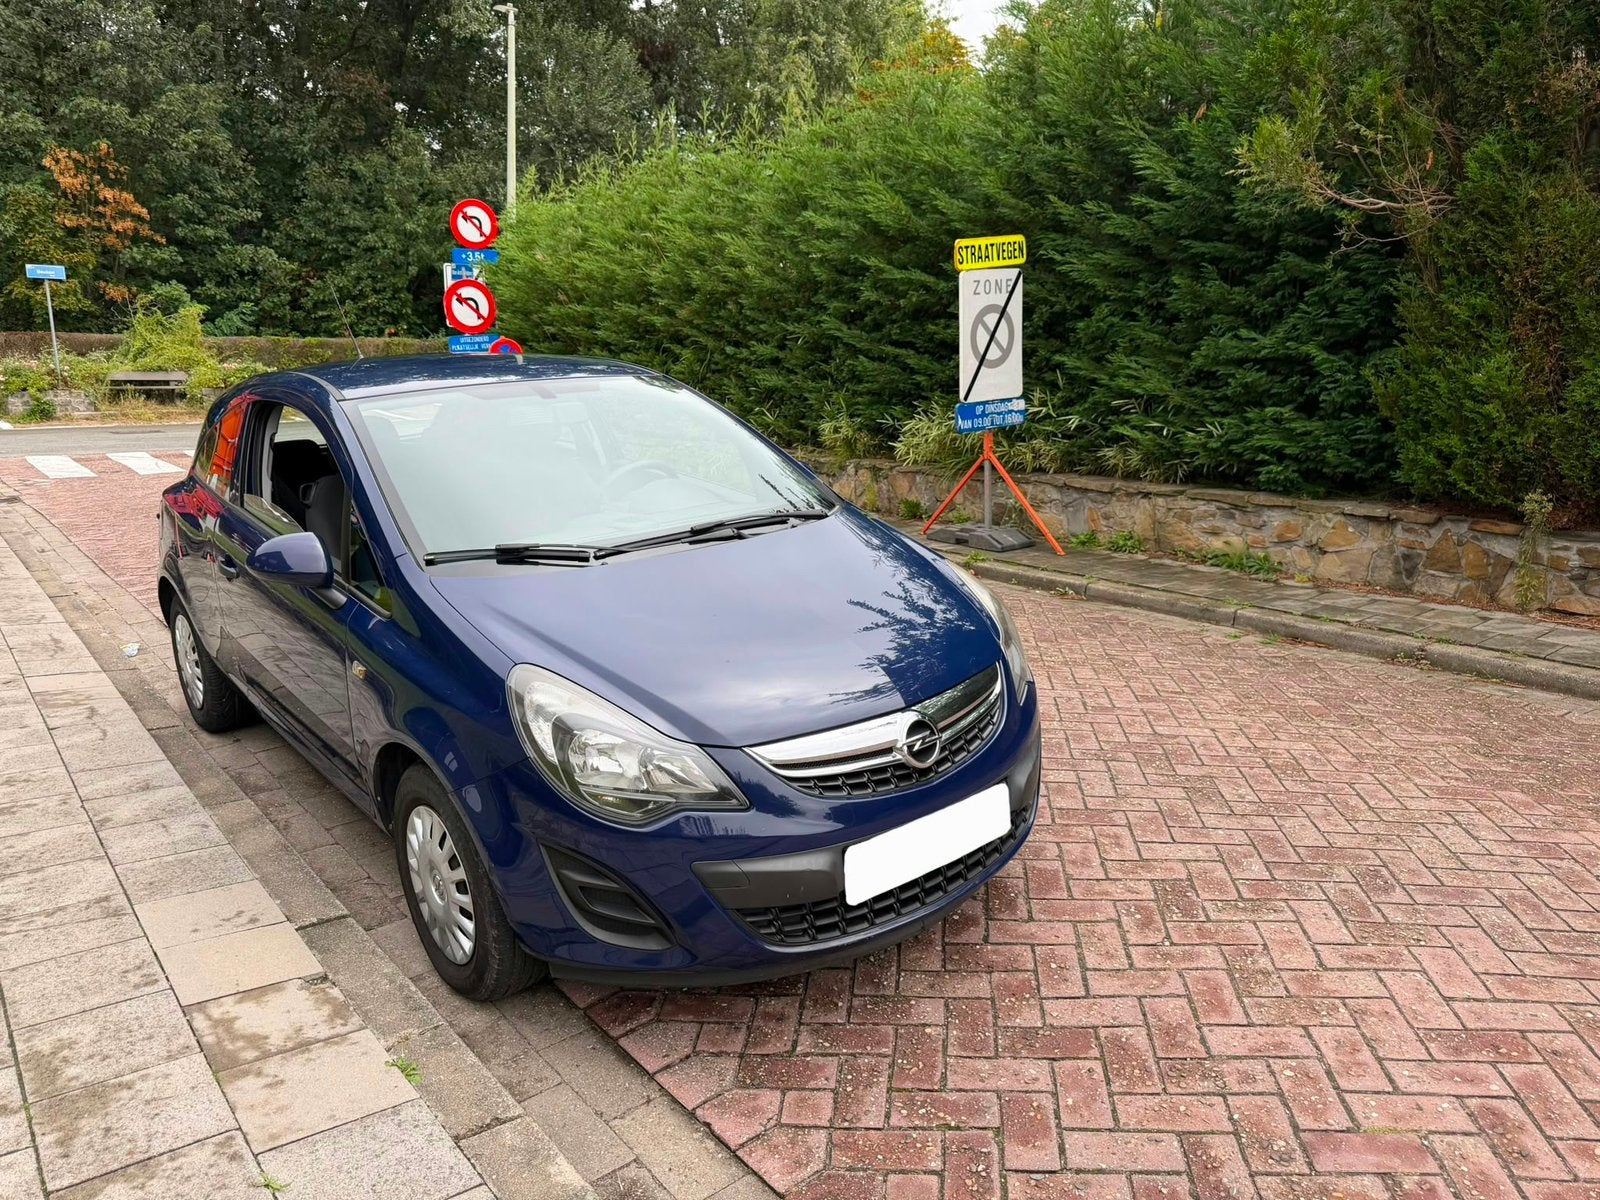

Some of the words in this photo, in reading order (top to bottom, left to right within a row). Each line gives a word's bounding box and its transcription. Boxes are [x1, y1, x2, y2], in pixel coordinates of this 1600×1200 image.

[957, 240, 1024, 265] STRAATVEGEN
[973, 278, 1013, 296] ZONE
[975, 405, 984, 415] OP
[960, 418, 972, 429] VAN
[993, 413, 1004, 426] TOT
